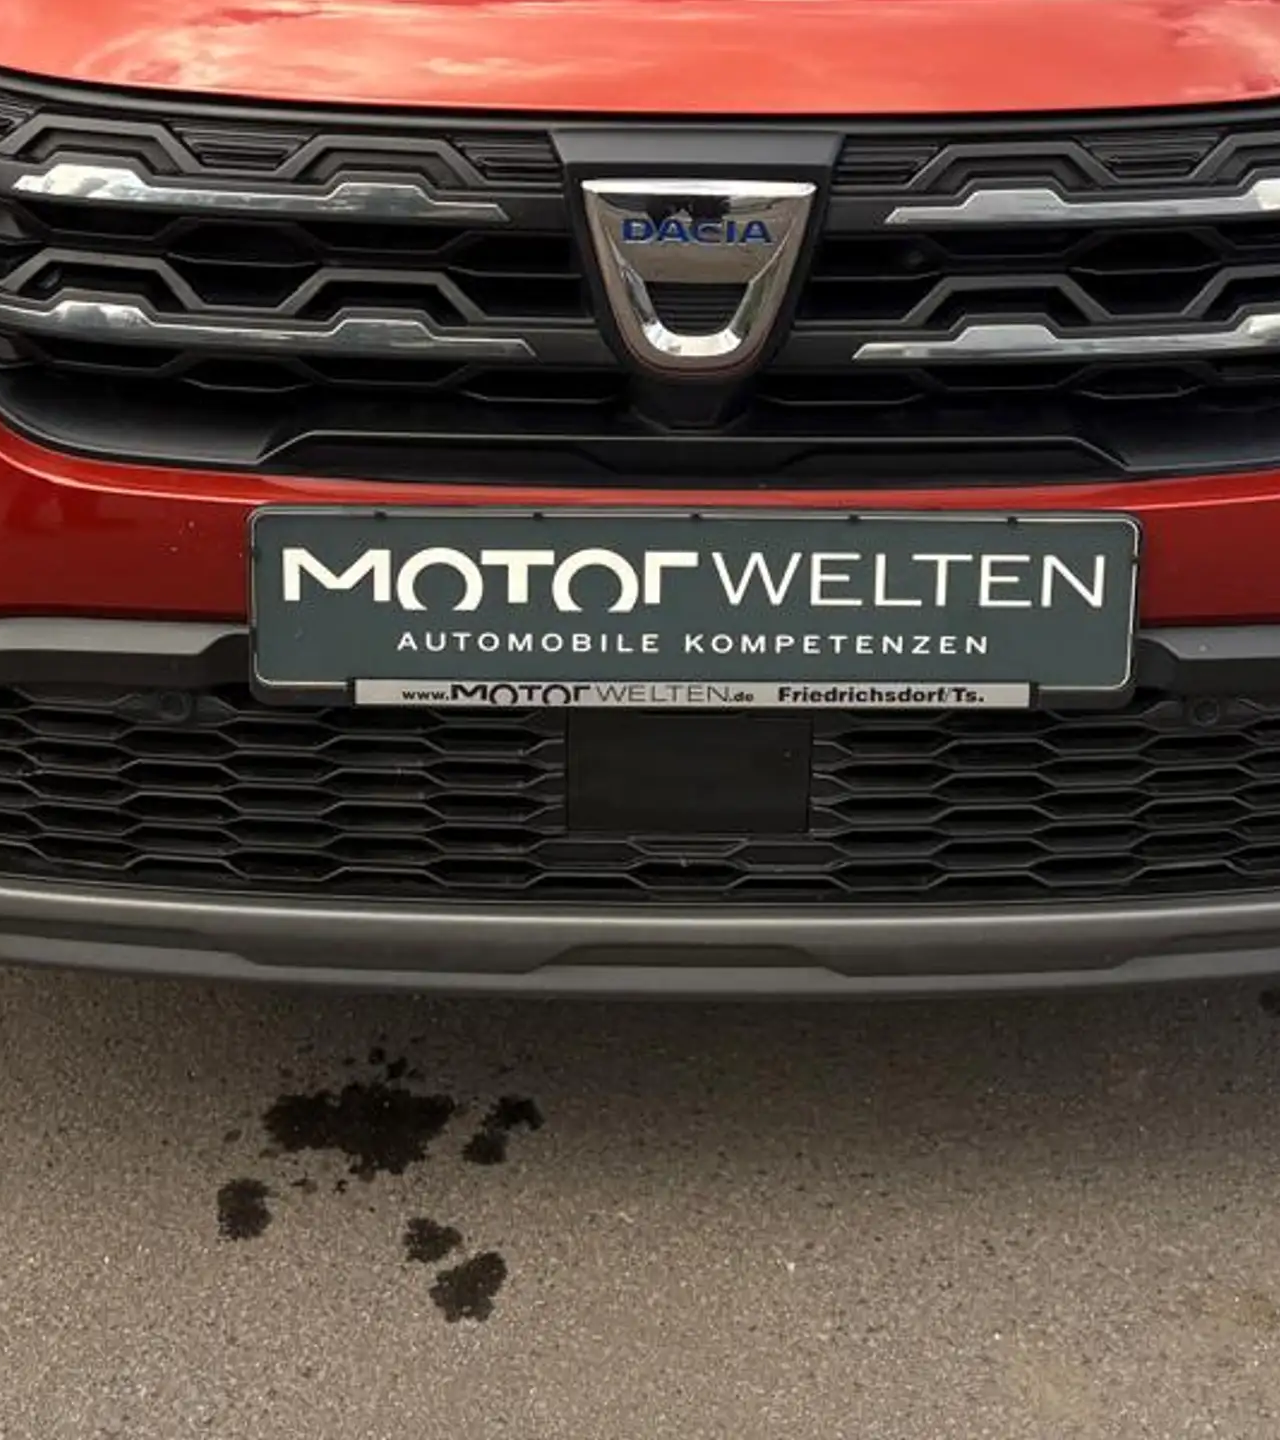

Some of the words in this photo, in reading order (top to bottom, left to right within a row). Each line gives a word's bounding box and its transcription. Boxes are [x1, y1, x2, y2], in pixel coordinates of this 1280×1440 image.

[622, 218, 773, 244] DACIA
[397, 631, 659, 653] AUTOMOBILE
[684, 633, 987, 655] KOMPETENZEN
